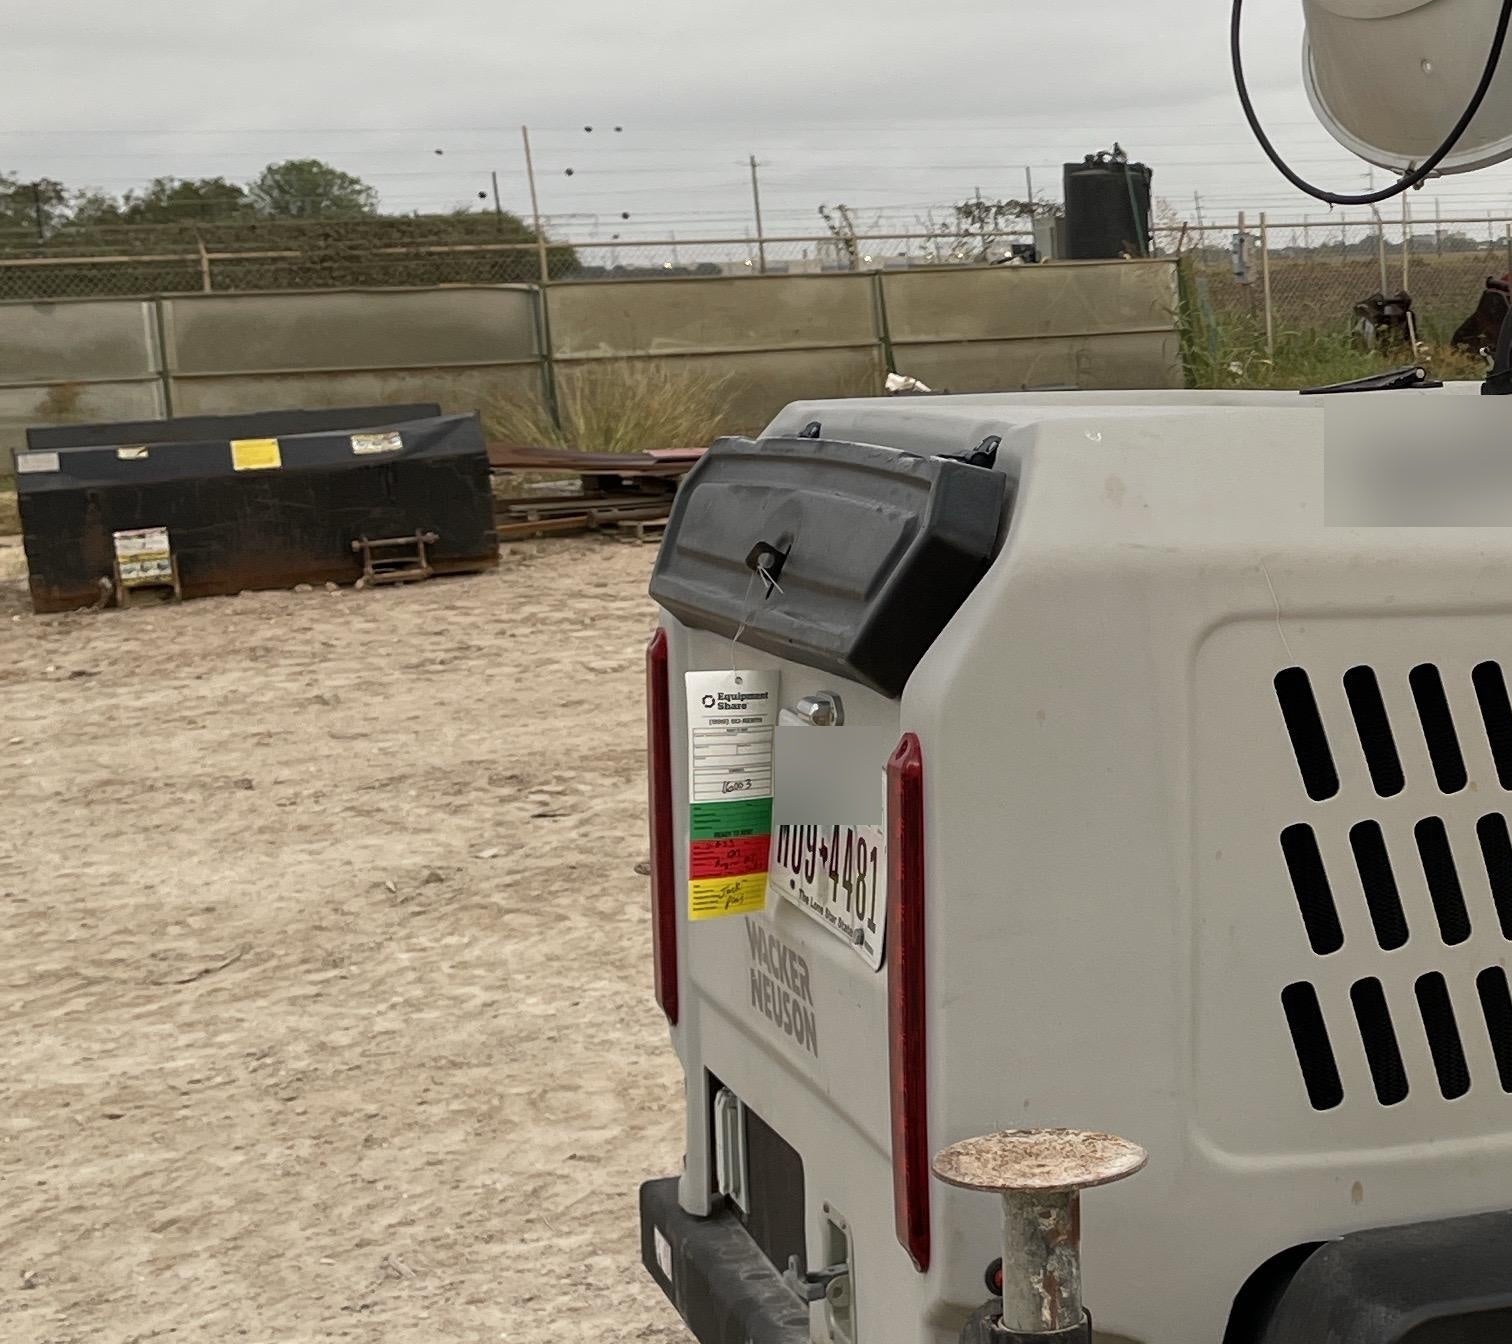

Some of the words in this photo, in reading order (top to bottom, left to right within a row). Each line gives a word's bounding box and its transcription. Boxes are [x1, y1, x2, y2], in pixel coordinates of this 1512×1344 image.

[717, 702, 747, 710] Share
[745, 916, 814, 1007] WACKER
[750, 967, 818, 1059] NEUSON
